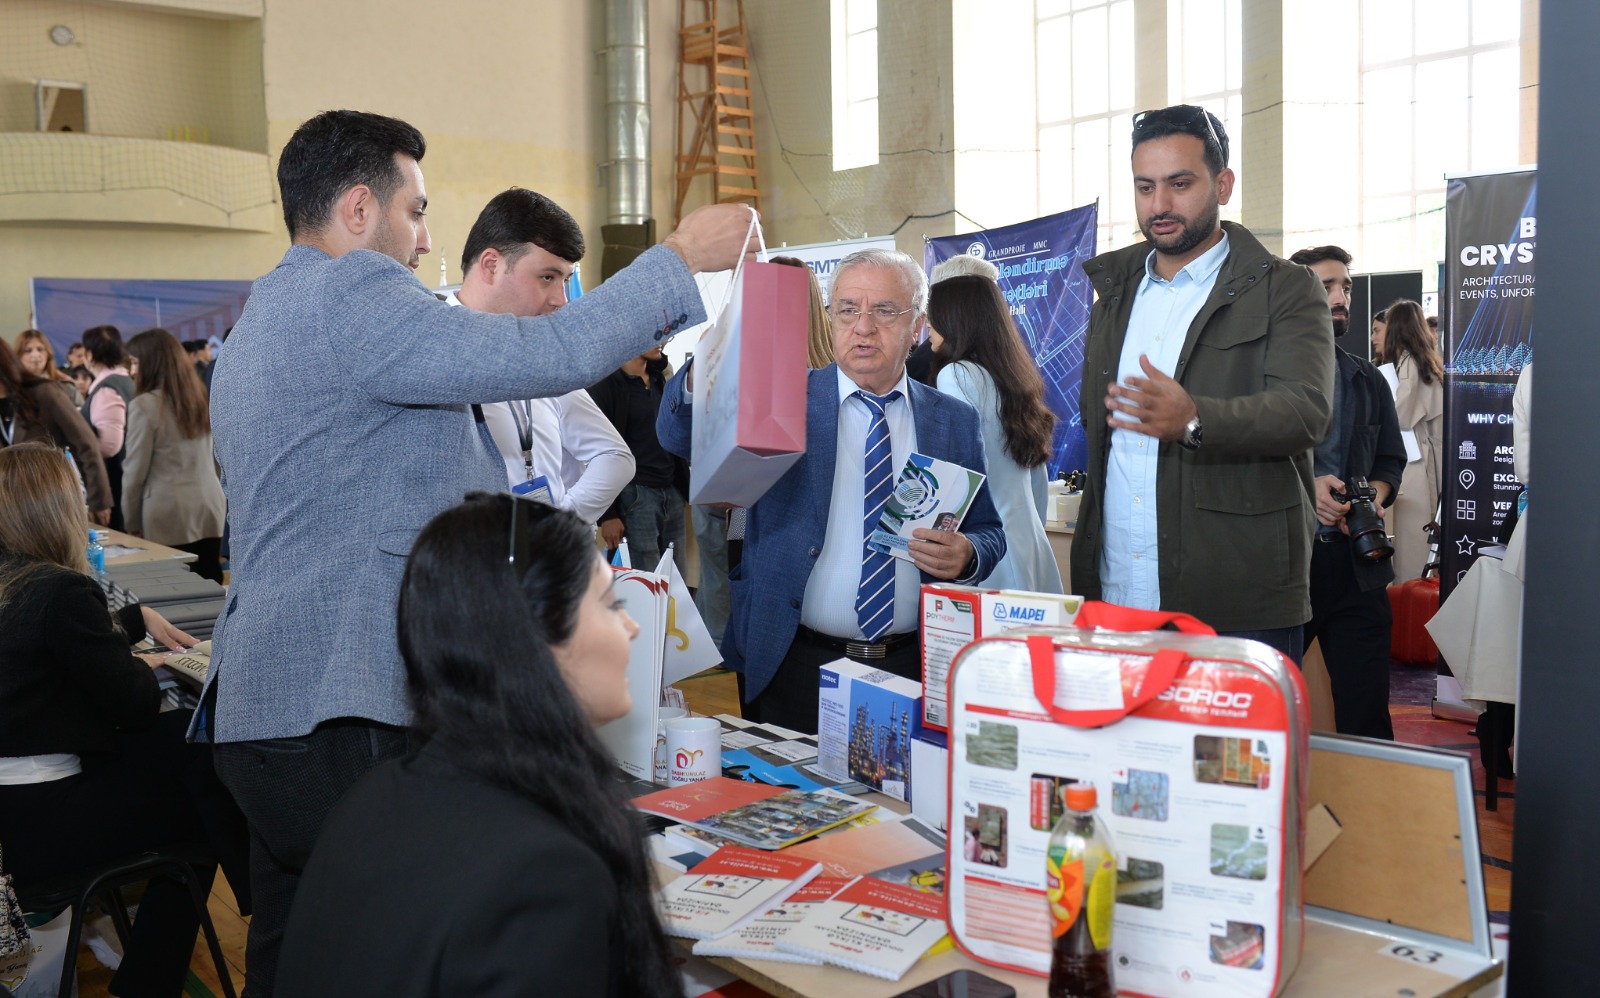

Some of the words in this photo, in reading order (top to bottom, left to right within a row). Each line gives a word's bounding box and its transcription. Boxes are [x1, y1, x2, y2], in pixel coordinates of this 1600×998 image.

[1520, 217, 1536, 238] B
[1033, 239, 1048, 250] MMC
[1460, 242, 1536, 267] CRYS
[806, 258, 842, 275] MT
[999, 255, 1069, 279] ləndirmə
[1460, 289, 1499, 300] EVENTS,
[1501, 287, 1536, 299] UNFOR
[1468, 413, 1495, 424] WHY
[1498, 413, 1514, 424] CH
[1494, 446, 1514, 455] ARC
[1494, 456, 1514, 464] Desig
[1493, 473, 1521, 483] EXCE
[1493, 501, 1513, 511] VER
[1009, 606, 1045, 622] MAPEI
[1391, 946, 1443, 964] 63
